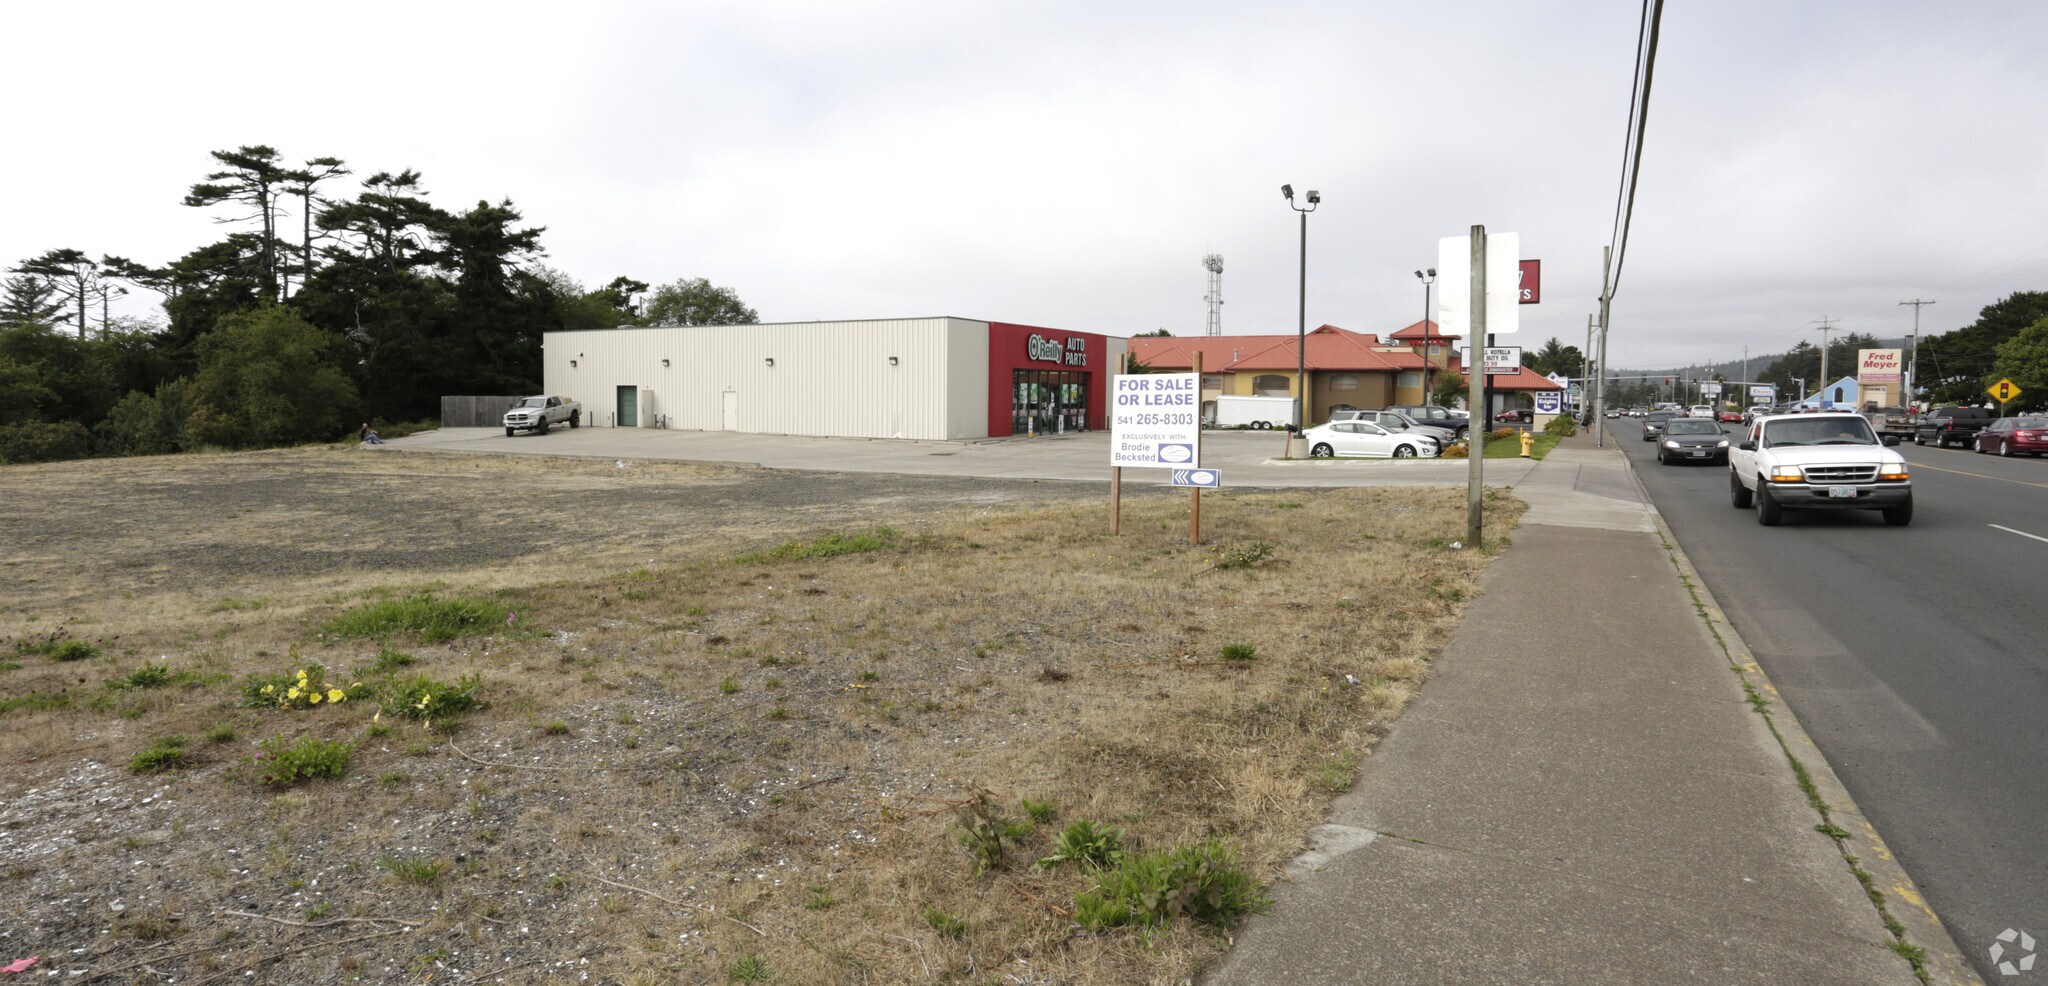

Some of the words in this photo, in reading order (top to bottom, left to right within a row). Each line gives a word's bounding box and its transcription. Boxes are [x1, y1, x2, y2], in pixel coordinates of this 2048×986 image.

[1029, 334, 1063, 364] O'Reilly
[1067, 337, 1085, 351] AUTO
[1065, 352, 1087, 366] PARTS
[1868, 352, 1894, 360] Fred
[1863, 360, 1898, 369] Meyer
[1119, 379, 1150, 391] FOR
[1154, 378, 1193, 391] SALE
[1118, 394, 1139, 406] OR
[1145, 393, 1193, 406] LEASE
[1117, 416, 1133, 425] 541
[1136, 413, 1193, 425] 265-8303
[1121, 442, 1150, 451] Brodie
[1115, 452, 1156, 461] Becksted
